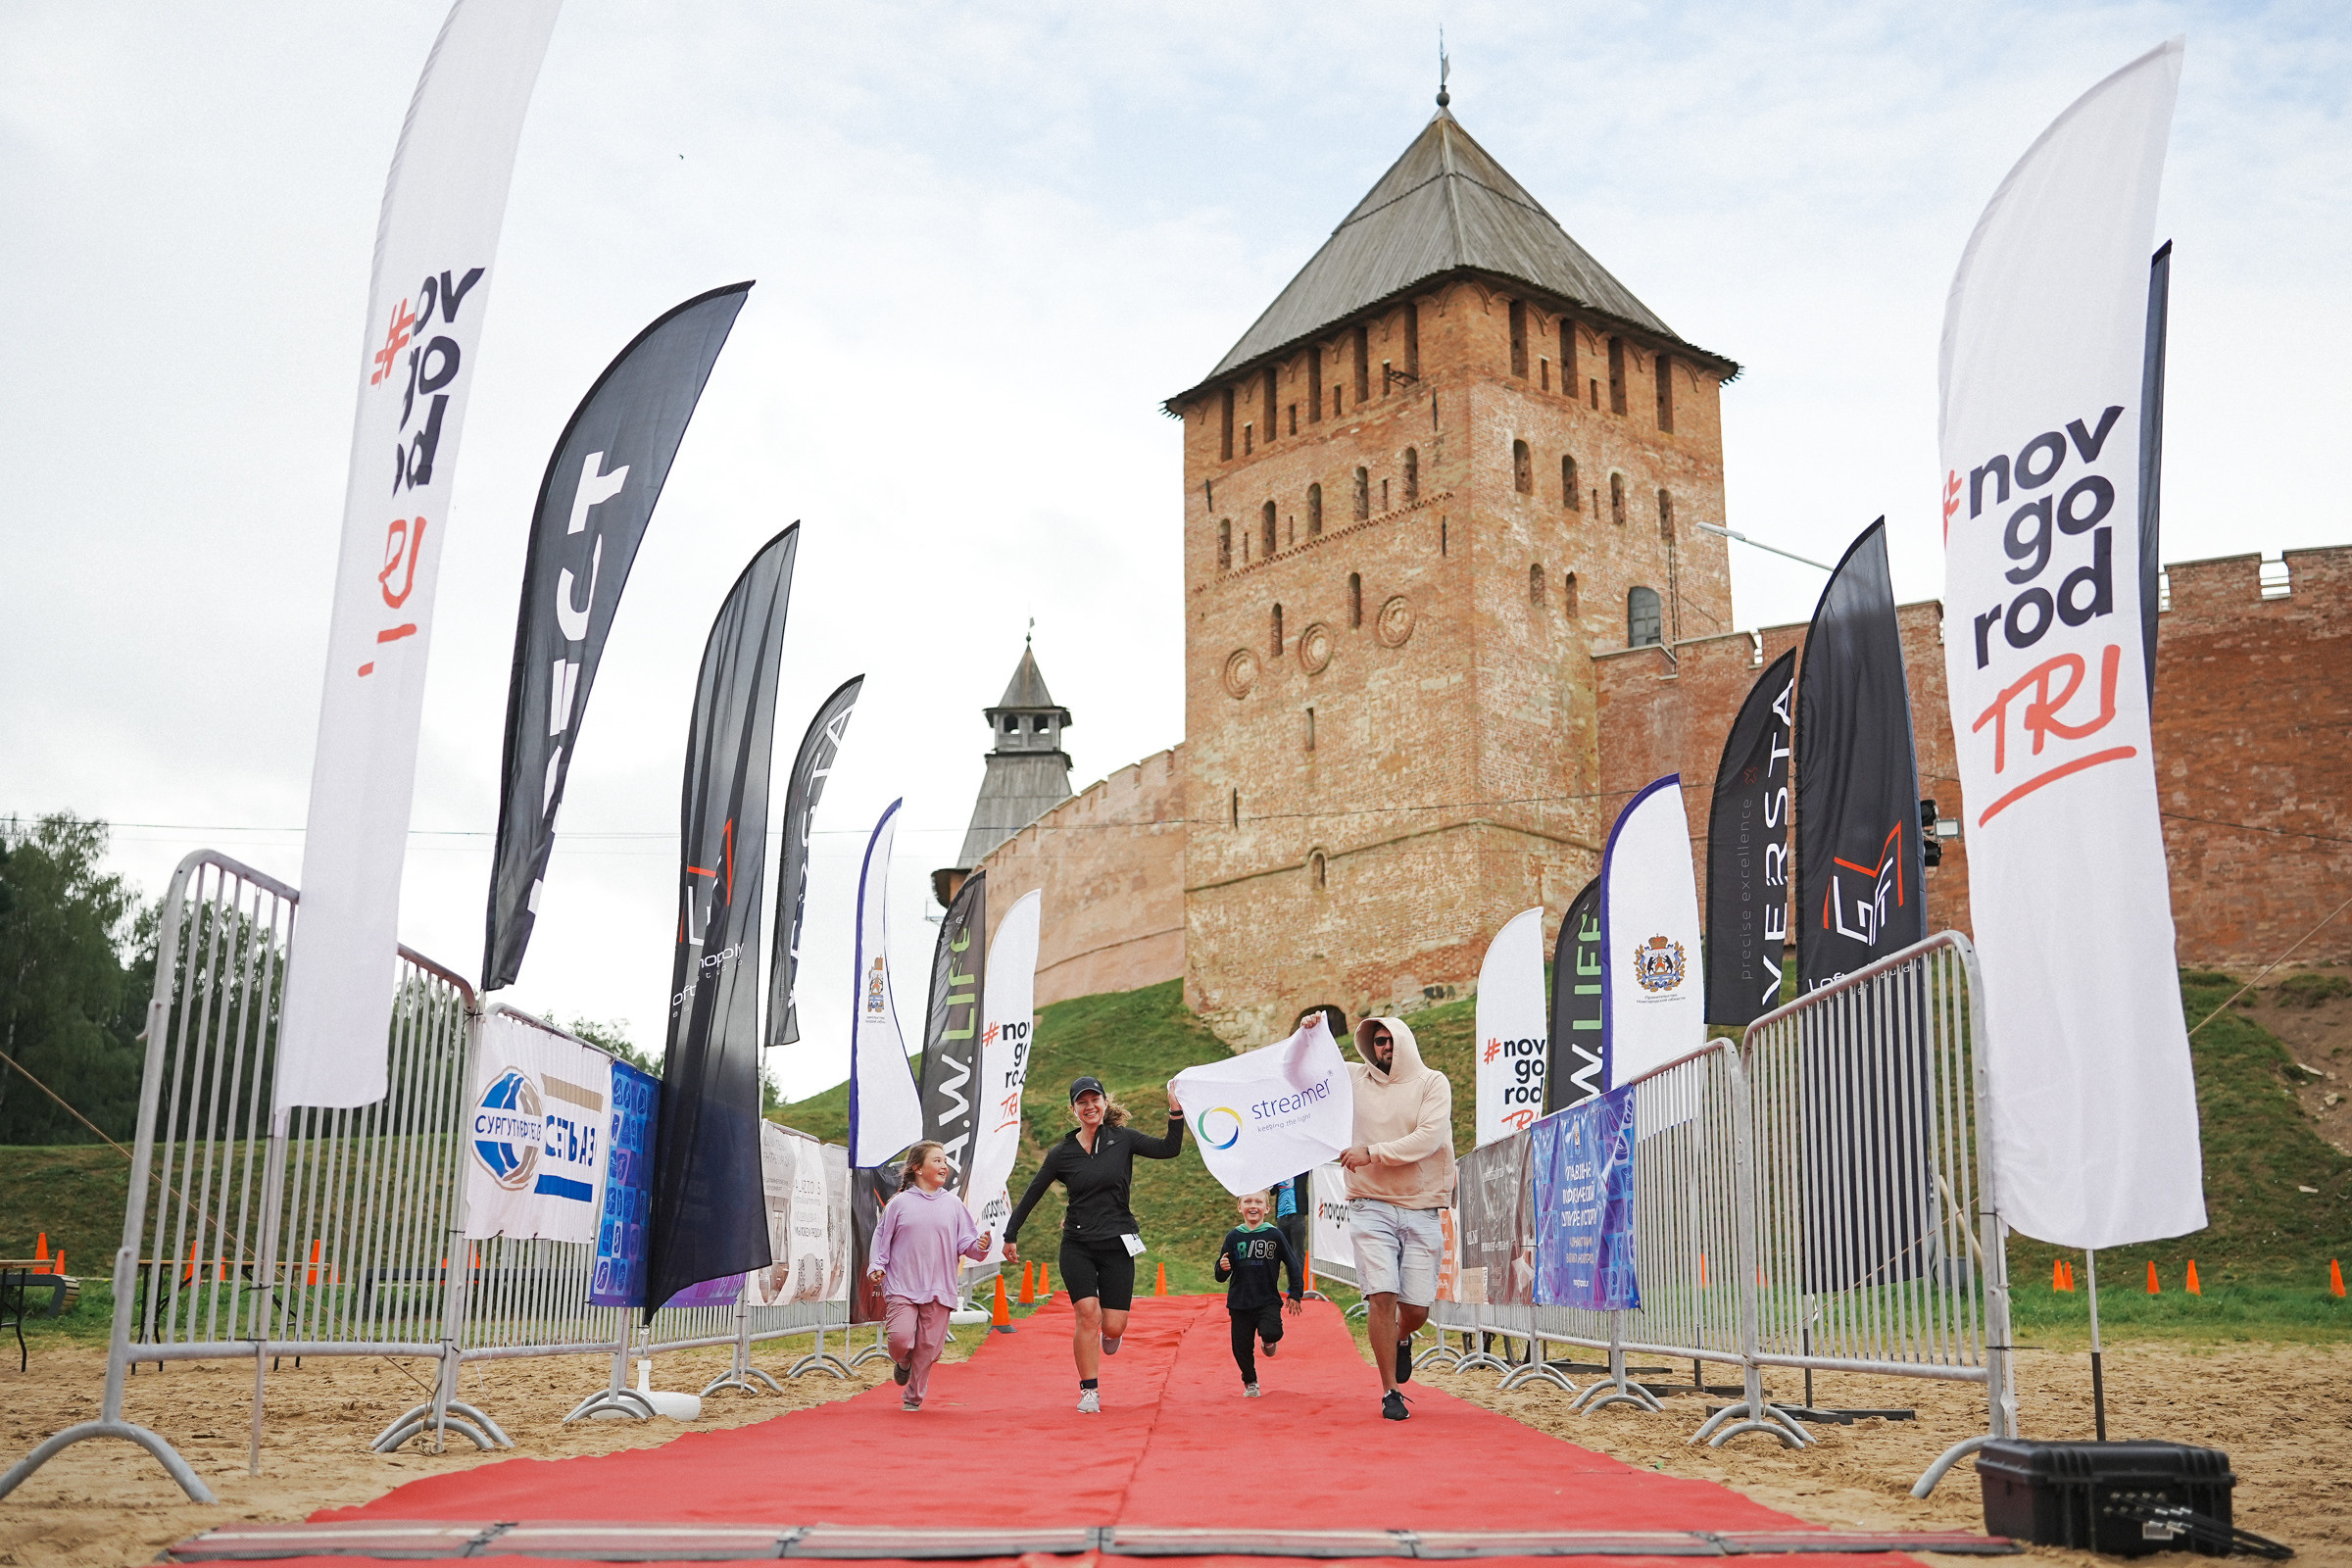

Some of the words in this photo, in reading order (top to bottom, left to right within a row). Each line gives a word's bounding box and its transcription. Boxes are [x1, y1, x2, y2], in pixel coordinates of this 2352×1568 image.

[2003, 474, 2116, 585] go
[1974, 526, 2114, 670] rod
[1972, 644, 2122, 774] TRI
[1737, 799, 1752, 902] excellence
[1762, 678, 1794, 1005] VERSTA
[1741, 909, 1752, 980] precise
[1484, 1038, 1545, 1064] #nov
[1504, 1077, 1544, 1104] rod
[1515, 1059, 1544, 1083] go
[1257, 1122, 1285, 1132] keeping
[1298, 1113, 1311, 1123] light
